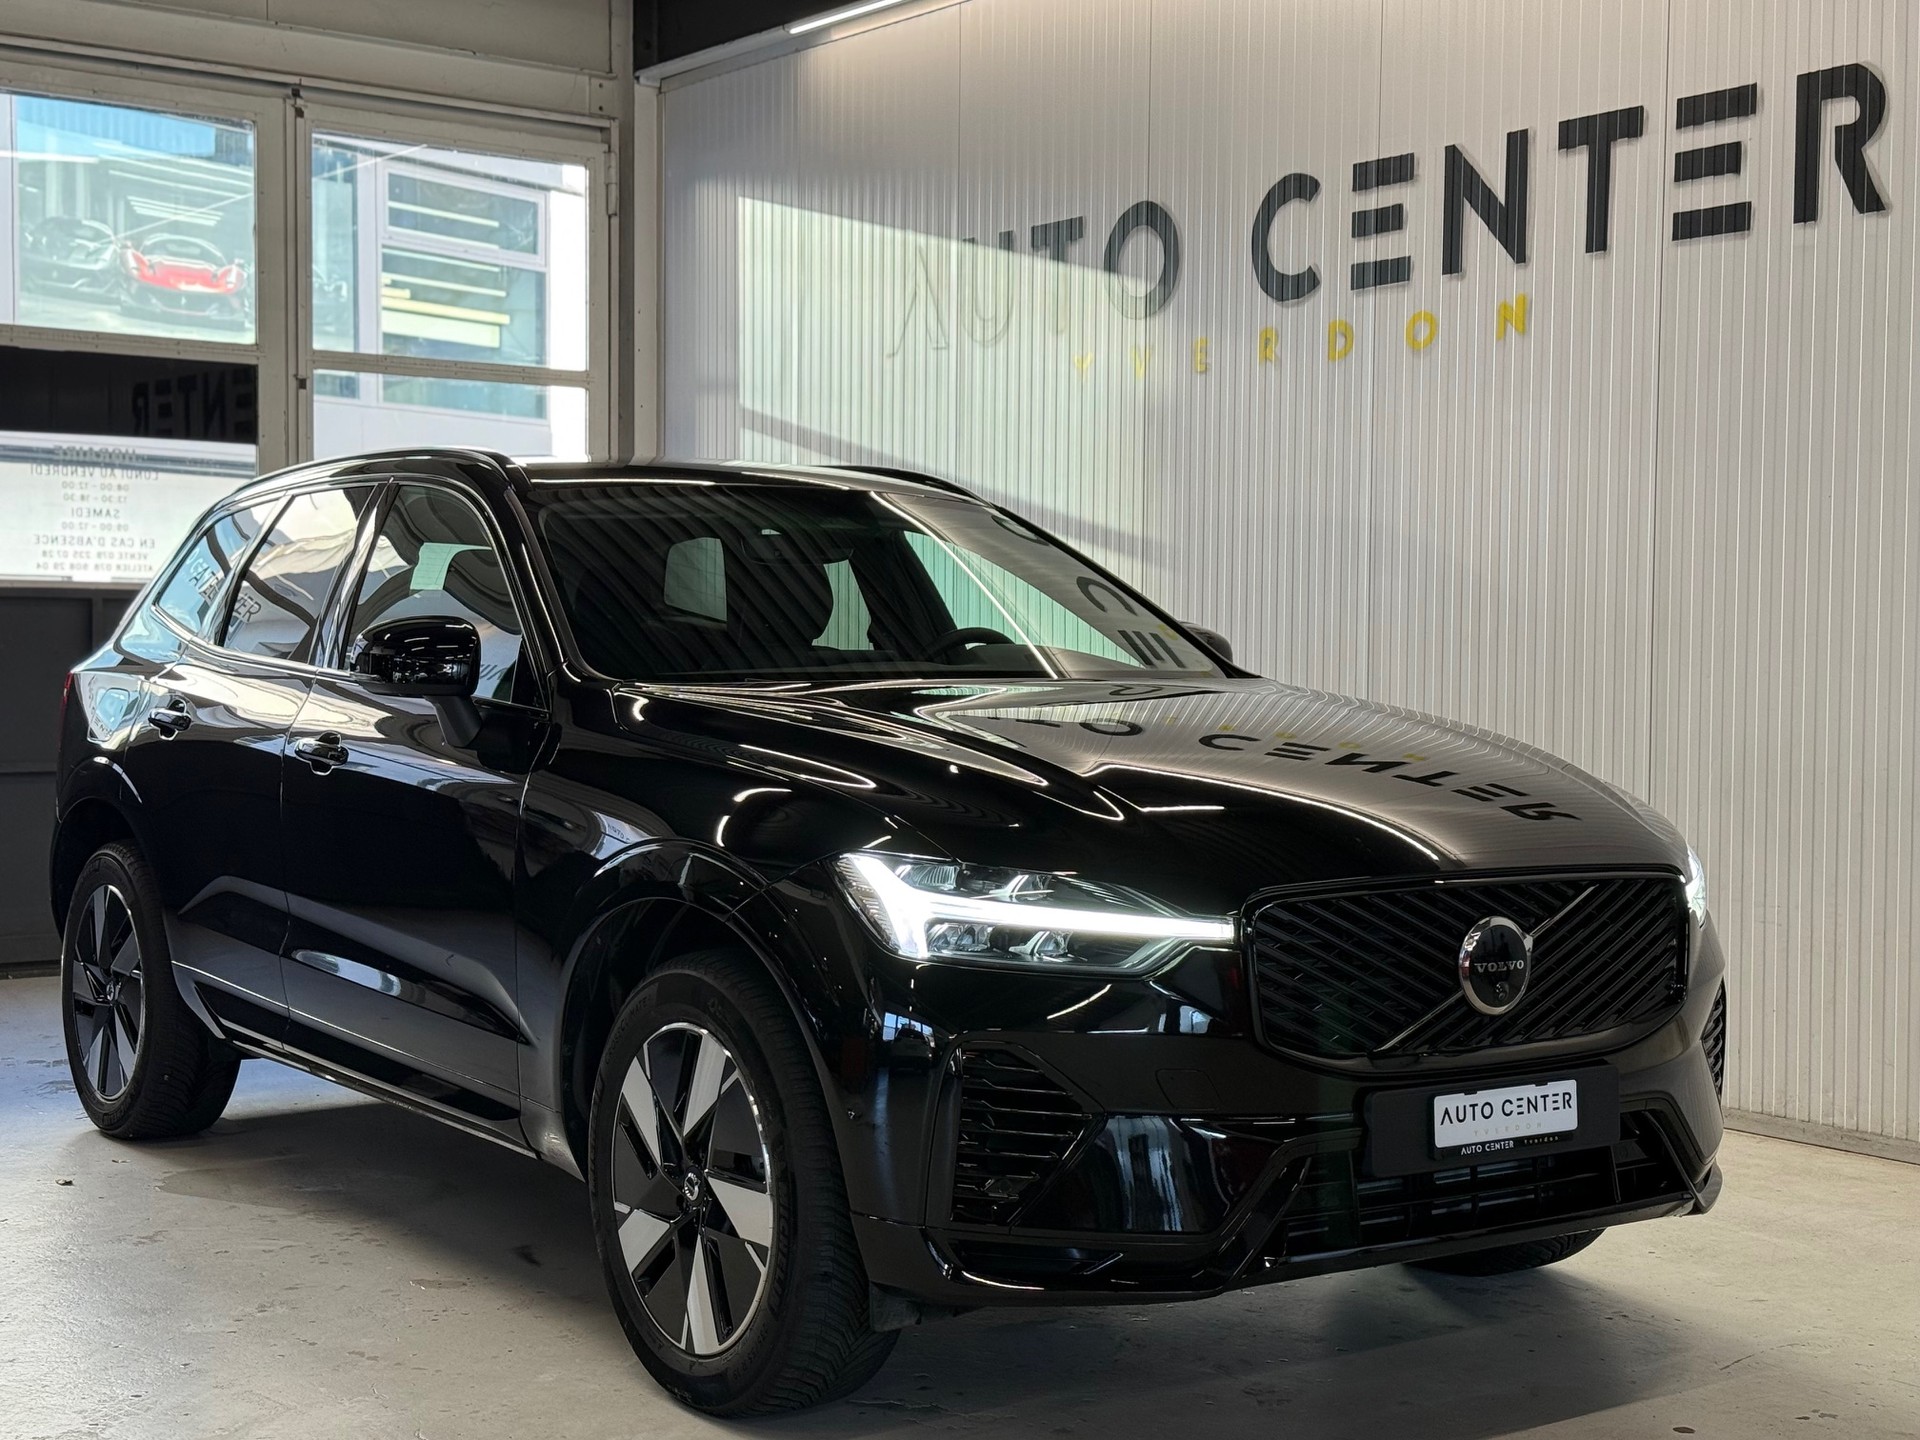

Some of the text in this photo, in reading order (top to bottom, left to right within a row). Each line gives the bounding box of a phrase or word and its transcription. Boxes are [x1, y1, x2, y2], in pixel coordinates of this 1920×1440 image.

[885, 63, 1888, 359] AUTO CENTER
[1073, 294, 1528, 383] YVERDON
[1474, 959, 1525, 973] VOLVO
[1440, 1091, 1573, 1126] AUTO CENTER
[1460, 1143, 1483, 1156] AUTO
[1485, 1140, 1515, 1152] CENTER
